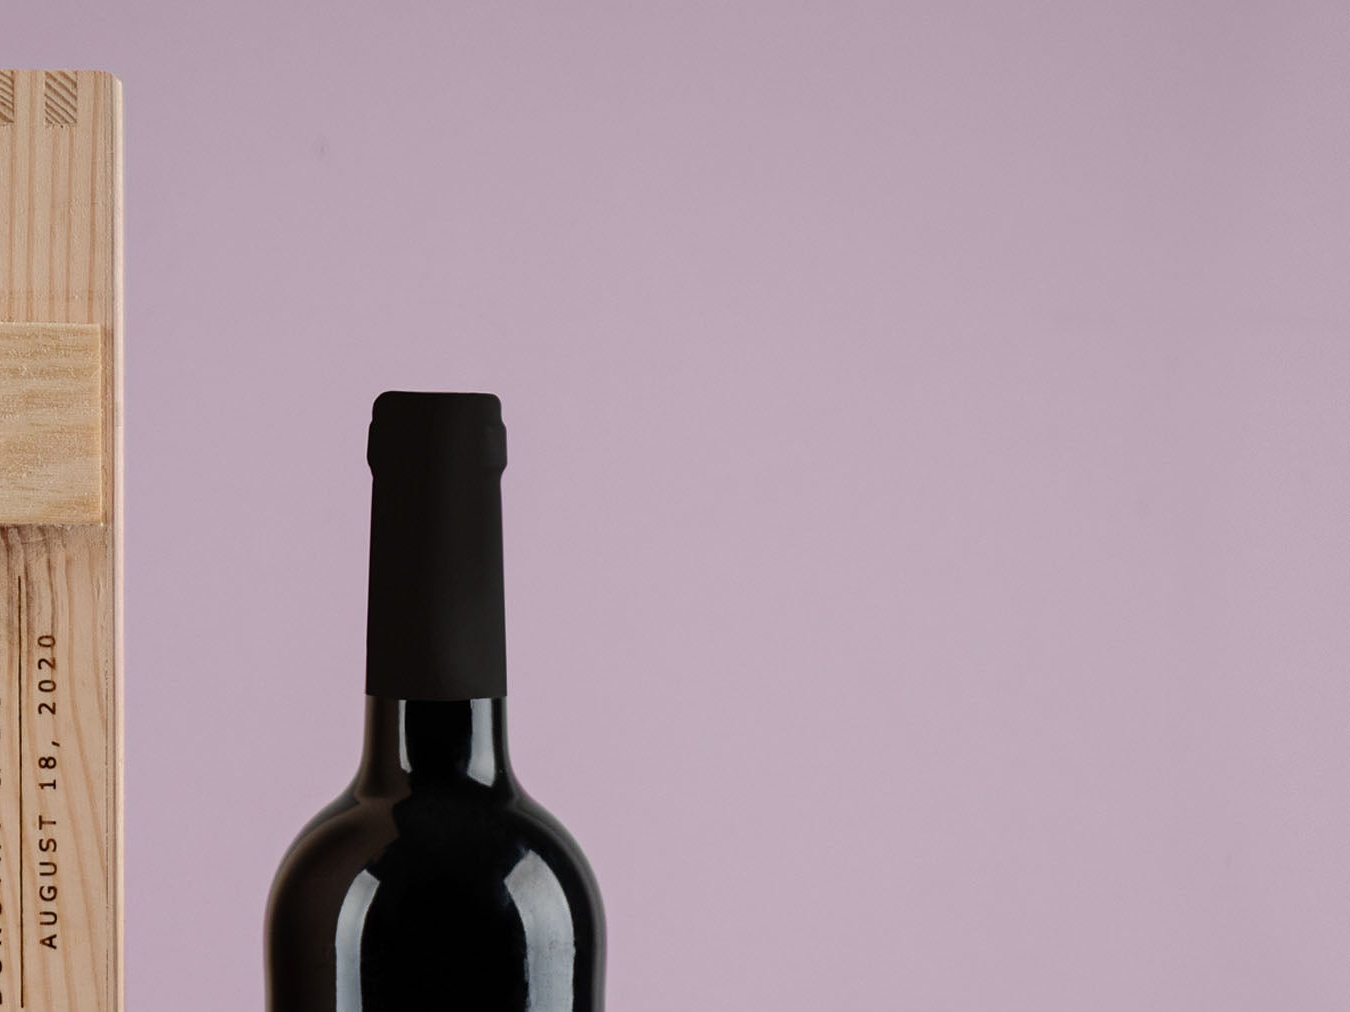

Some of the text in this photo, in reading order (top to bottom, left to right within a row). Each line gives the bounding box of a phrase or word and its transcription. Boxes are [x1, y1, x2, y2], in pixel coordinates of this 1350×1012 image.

[37, 633, 60, 950] AUGUST 18, 2020
